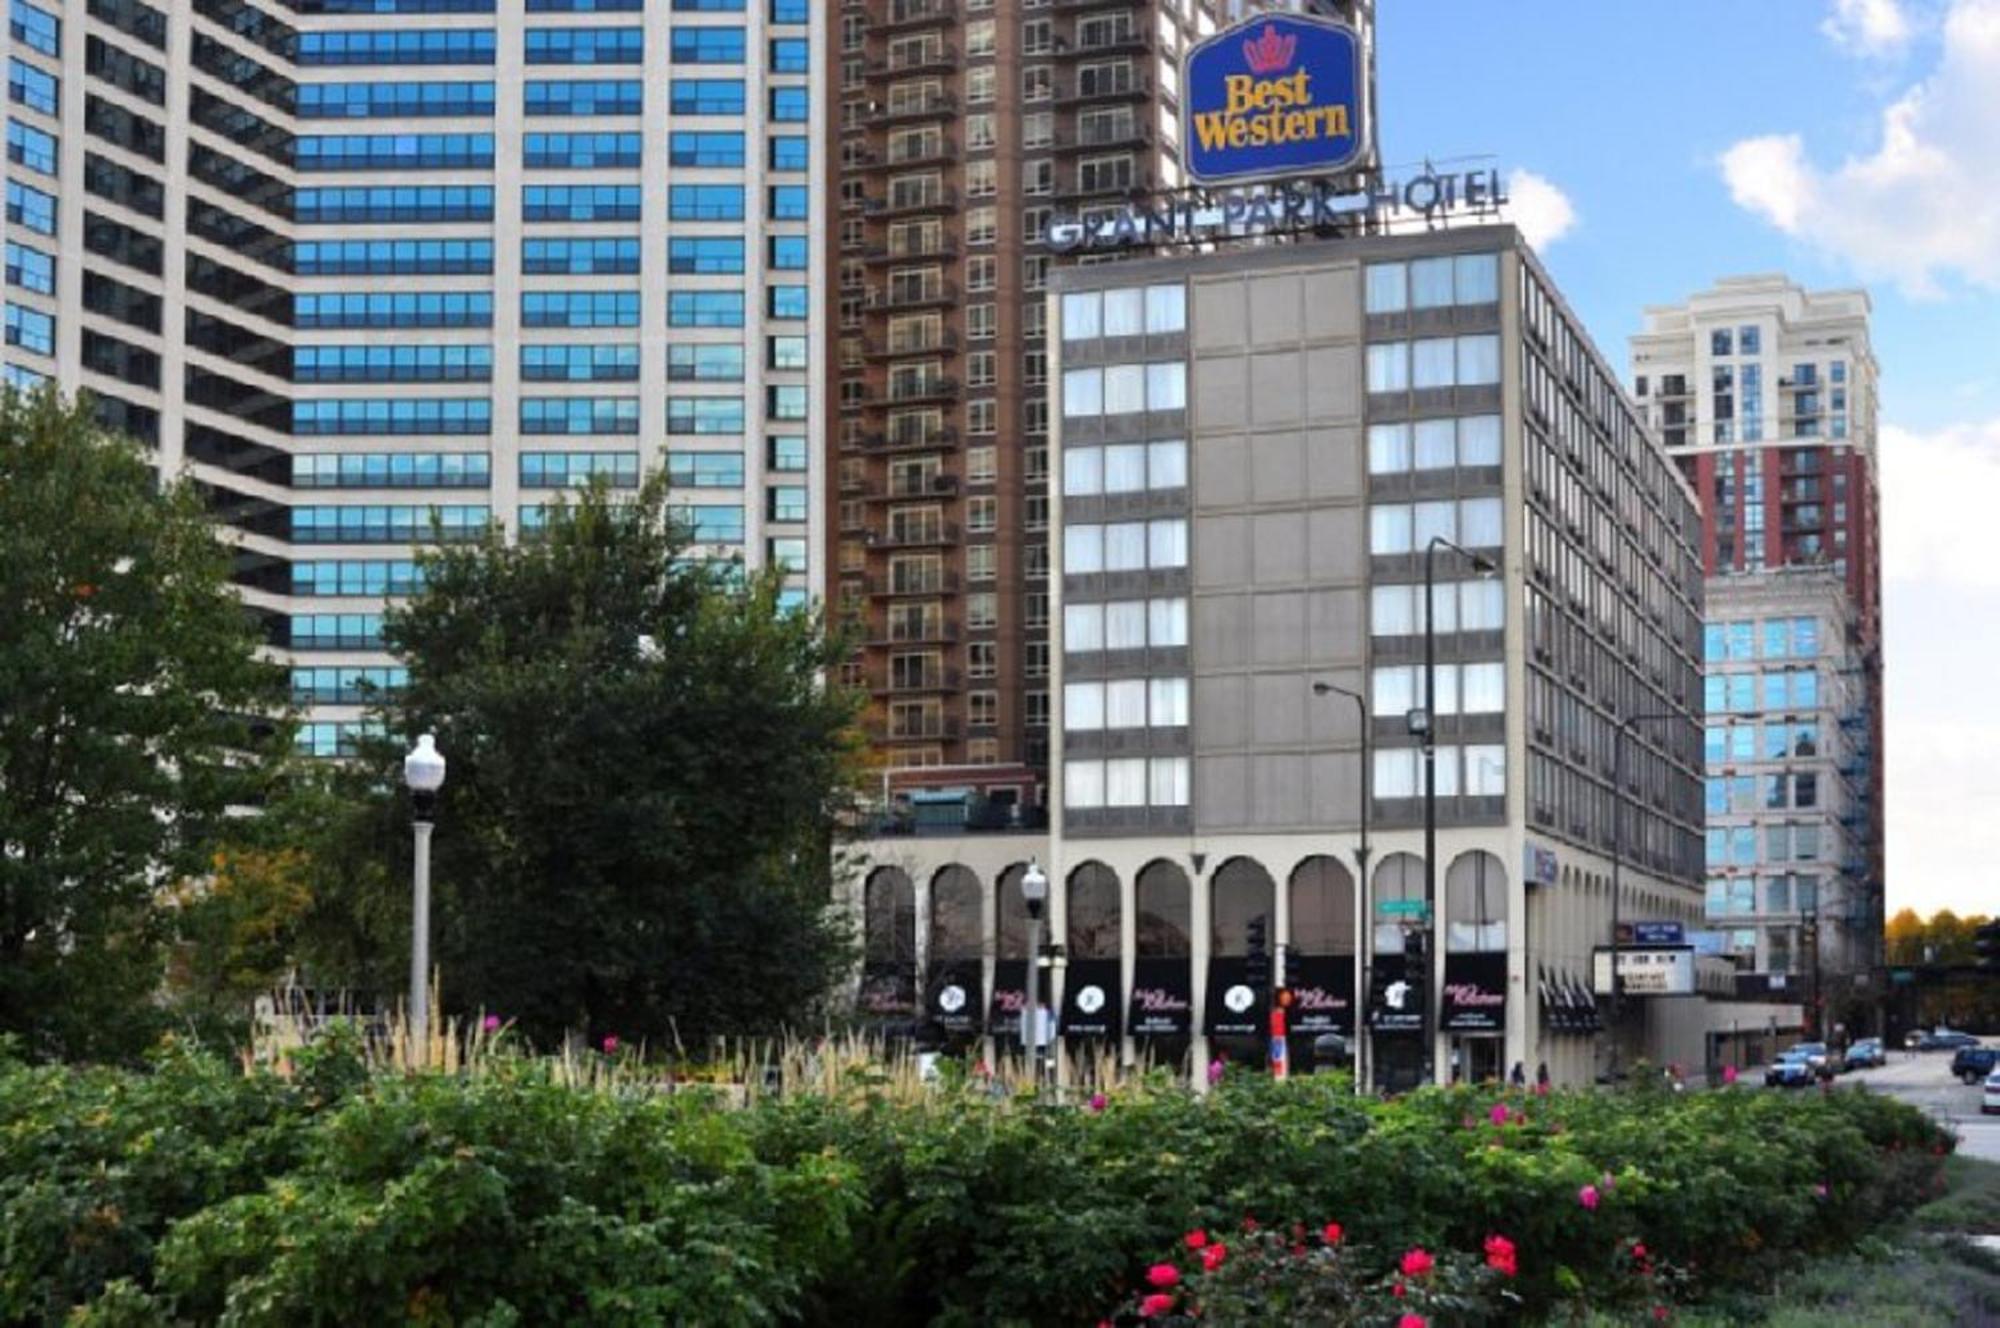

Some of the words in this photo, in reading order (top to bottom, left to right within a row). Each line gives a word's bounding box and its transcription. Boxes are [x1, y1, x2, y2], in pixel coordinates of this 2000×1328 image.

[1224, 67, 1312, 115] Best
[1193, 103, 1352, 152] Western
[1046, 198, 1201, 249] GRANT
[1224, 179, 1339, 227] PARK
[1367, 168, 1510, 217] HOTEL
